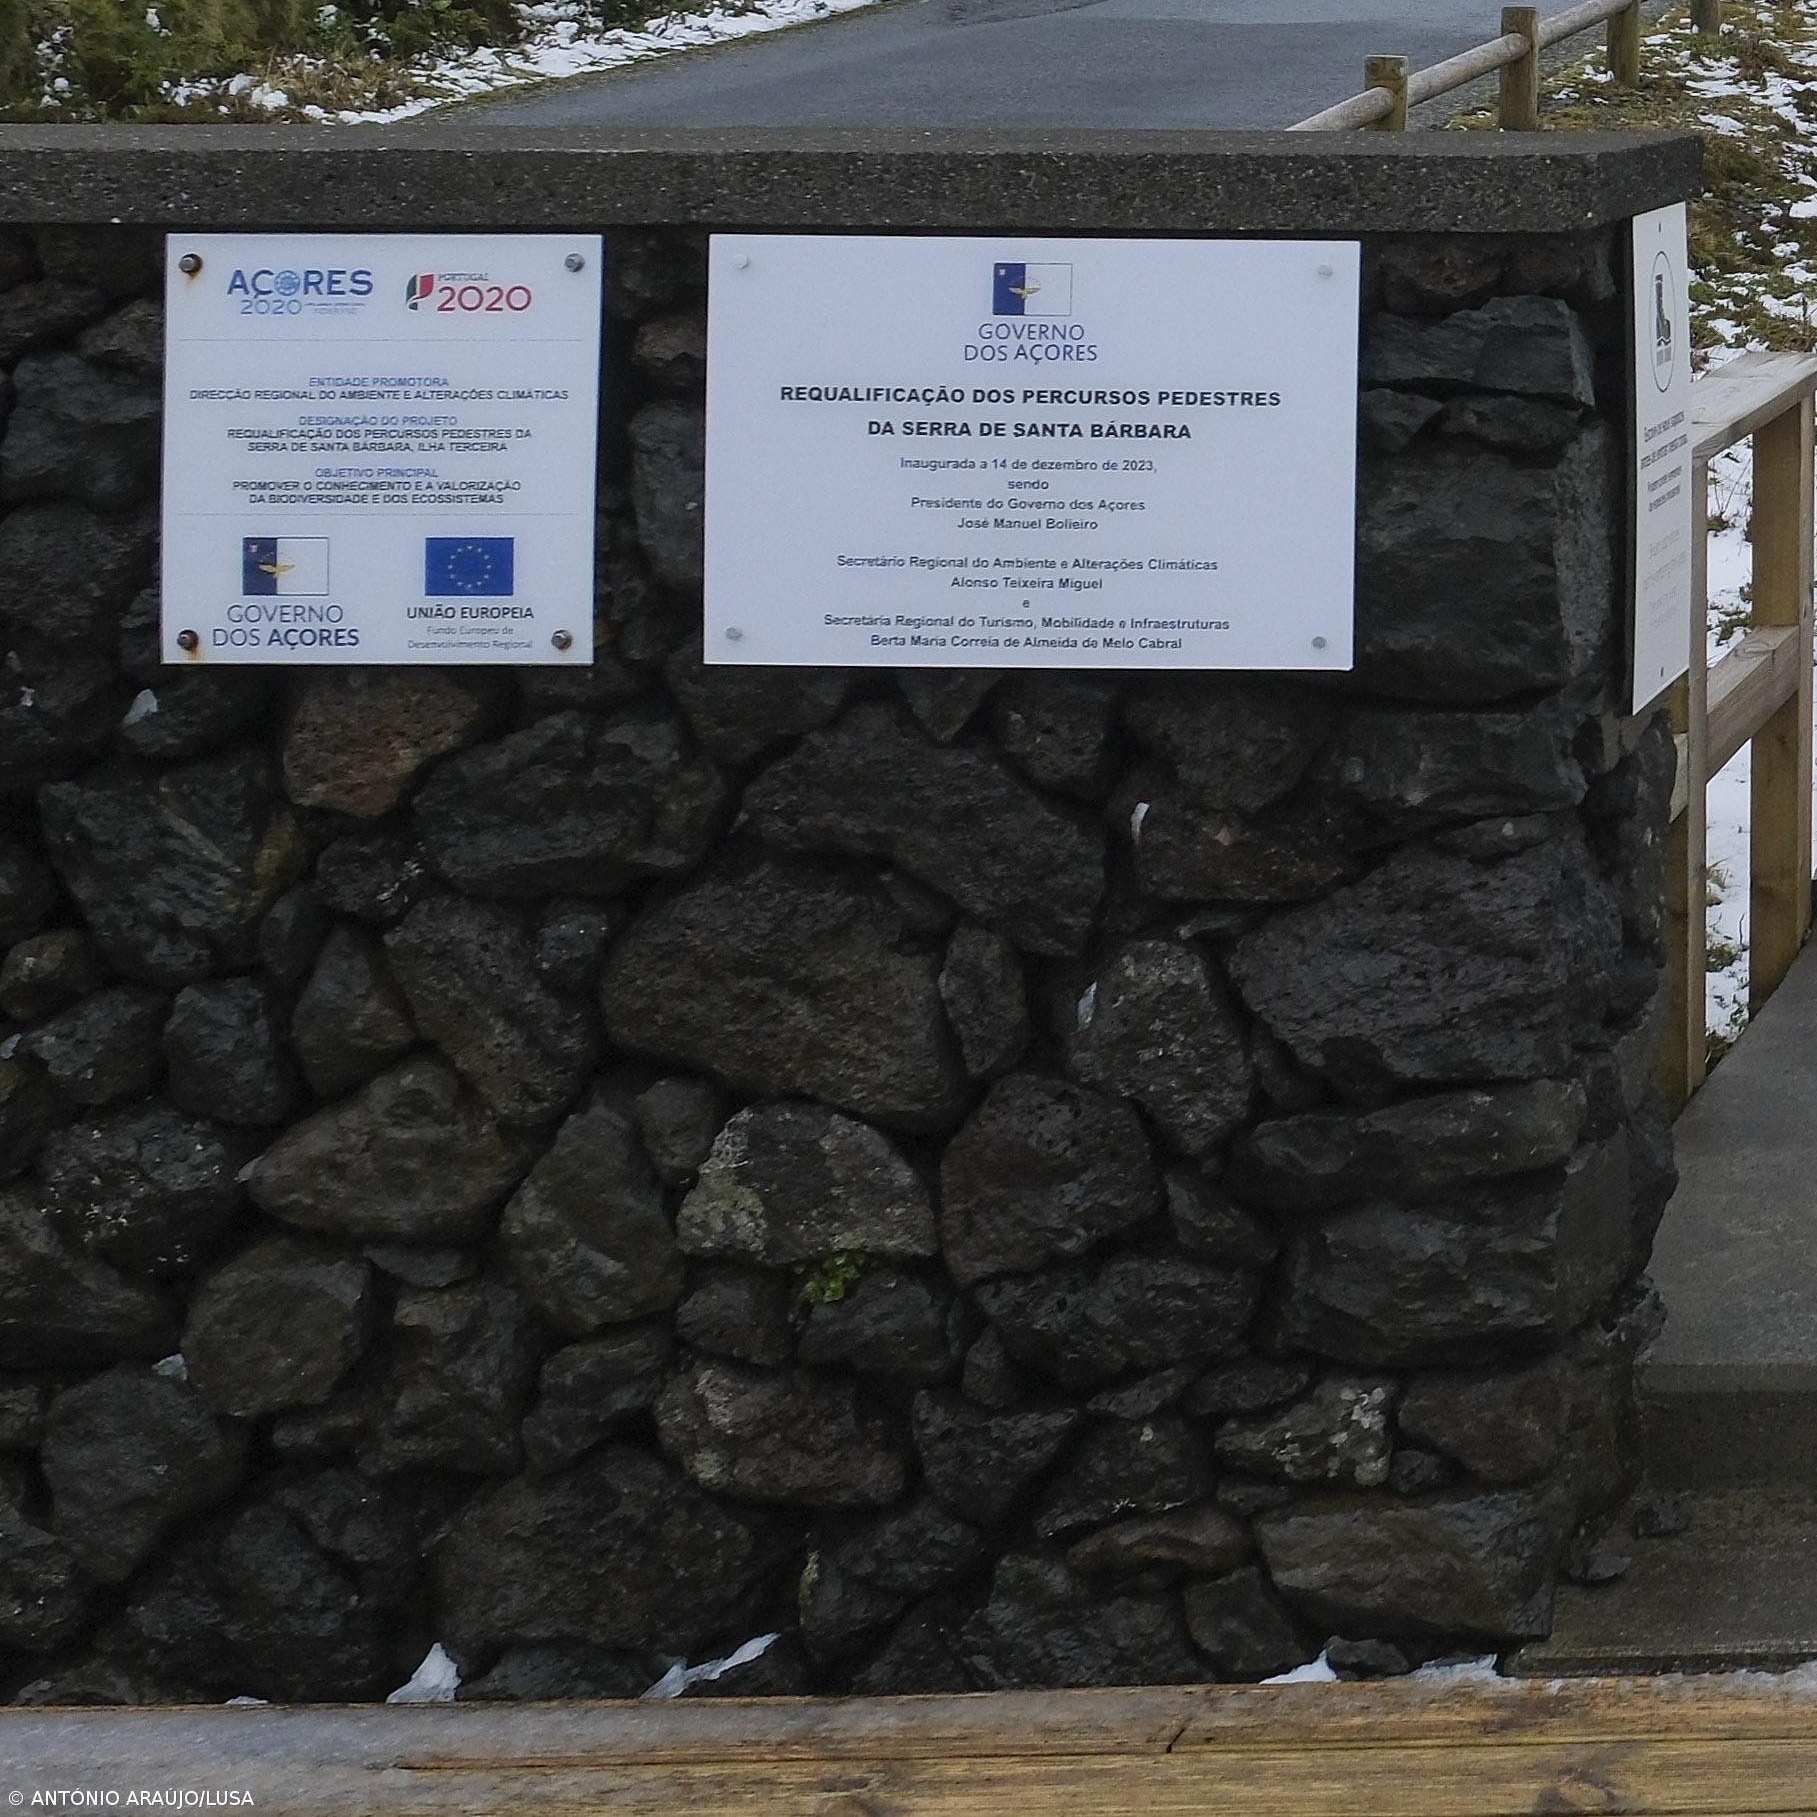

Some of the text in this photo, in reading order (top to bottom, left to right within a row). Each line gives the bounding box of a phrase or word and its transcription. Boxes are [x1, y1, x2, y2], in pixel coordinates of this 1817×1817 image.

[437, 272, 489, 282] PORTUGAL
[227, 269, 374, 302] AÇORES
[240, 296, 302, 315] 2020
[437, 285, 532, 312] 2020
[978, 323, 1085, 341] GOVERNO
[964, 343, 1098, 366] DOS AÇORES
[309, 377, 450, 387] ENTIDADE PROMOTORA
[254, 390, 317, 400] REGIONAL
[318, 390, 337, 400] DO
[339, 389, 401, 400] AMBIENTE
[403, 390, 412, 400] E
[413, 388, 494, 400] ALTERAÇÕES
[780, 385, 1281, 407] REQUALIFICAÇÃO DOS PERCURSOS PEDESTRES
[298, 415, 458, 426] DESIGNAÇÃO DO PROJETO
[227, 427, 532, 440] REQUALIFICAÇÃO DOS PERCURSOS PEDESTRES DA
[868, 420, 1192, 439] DA SERRA DE SANTA BÁRBARA
[247, 441, 288, 452] SERRA
[291, 442, 308, 452] DE
[310, 442, 350, 452] SANTA
[418, 442, 446, 452] ILHA
[449, 441, 508, 452] TERCEIRA
[314, 467, 439, 478] OBJETIVO PRINCIPAL
[900, 457, 1157, 473] Inaugurada a 14 de dezembro de 2023,
[233, 480, 521, 492] PROMOVER O CONHECIMENTO E A VALORIZAÇÃO
[1007, 479, 1049, 490] sendo
[249, 493, 504, 504] DA BIODIVERSIDADE E DOS ECOSSISTEMAS
[911, 496, 1146, 513] Presidente do Governo dos Açores
[993, 517, 1042, 530] Manuel
[909, 556, 968, 571] Regional
[972, 557, 990, 569] do
[992, 557, 1057, 569] Ambiente
[1060, 560, 1068, 569] e
[1071, 558, 1144, 572] Alterações
[1148, 558, 1218, 571] Climáticas
[1002, 576, 1054, 589] Teixeira
[1058, 577, 1103, 592] Miguel
[407, 603, 534, 619] UNIÃO EUROPEIA
[1022, 599, 1030, 608] e
[227, 604, 343, 624] GOVERNO
[895, 615, 954, 630] Regional
[958, 617, 976, 628] do
[978, 616, 1037, 630] Turismo,
[1041, 617, 1115, 629] Mobilidade
[1118, 620, 1127, 629] e
[1130, 617, 1230, 630] Infraestruturas
[426, 625, 514, 636] Fundo Europeu de
[213, 628, 360, 651] DOS AÇORES
[407, 639, 533, 651] Desenvolvimento Regional
[870, 634, 906, 646] Berta
[910, 635, 947, 647] Maria
[950, 635, 1000, 648] Correia
[1003, 637, 1020, 648] de
[1023, 637, 1078, 648] Almeida
[1081, 637, 1098, 649] de
[1138, 637, 1182, 649] Cabral
